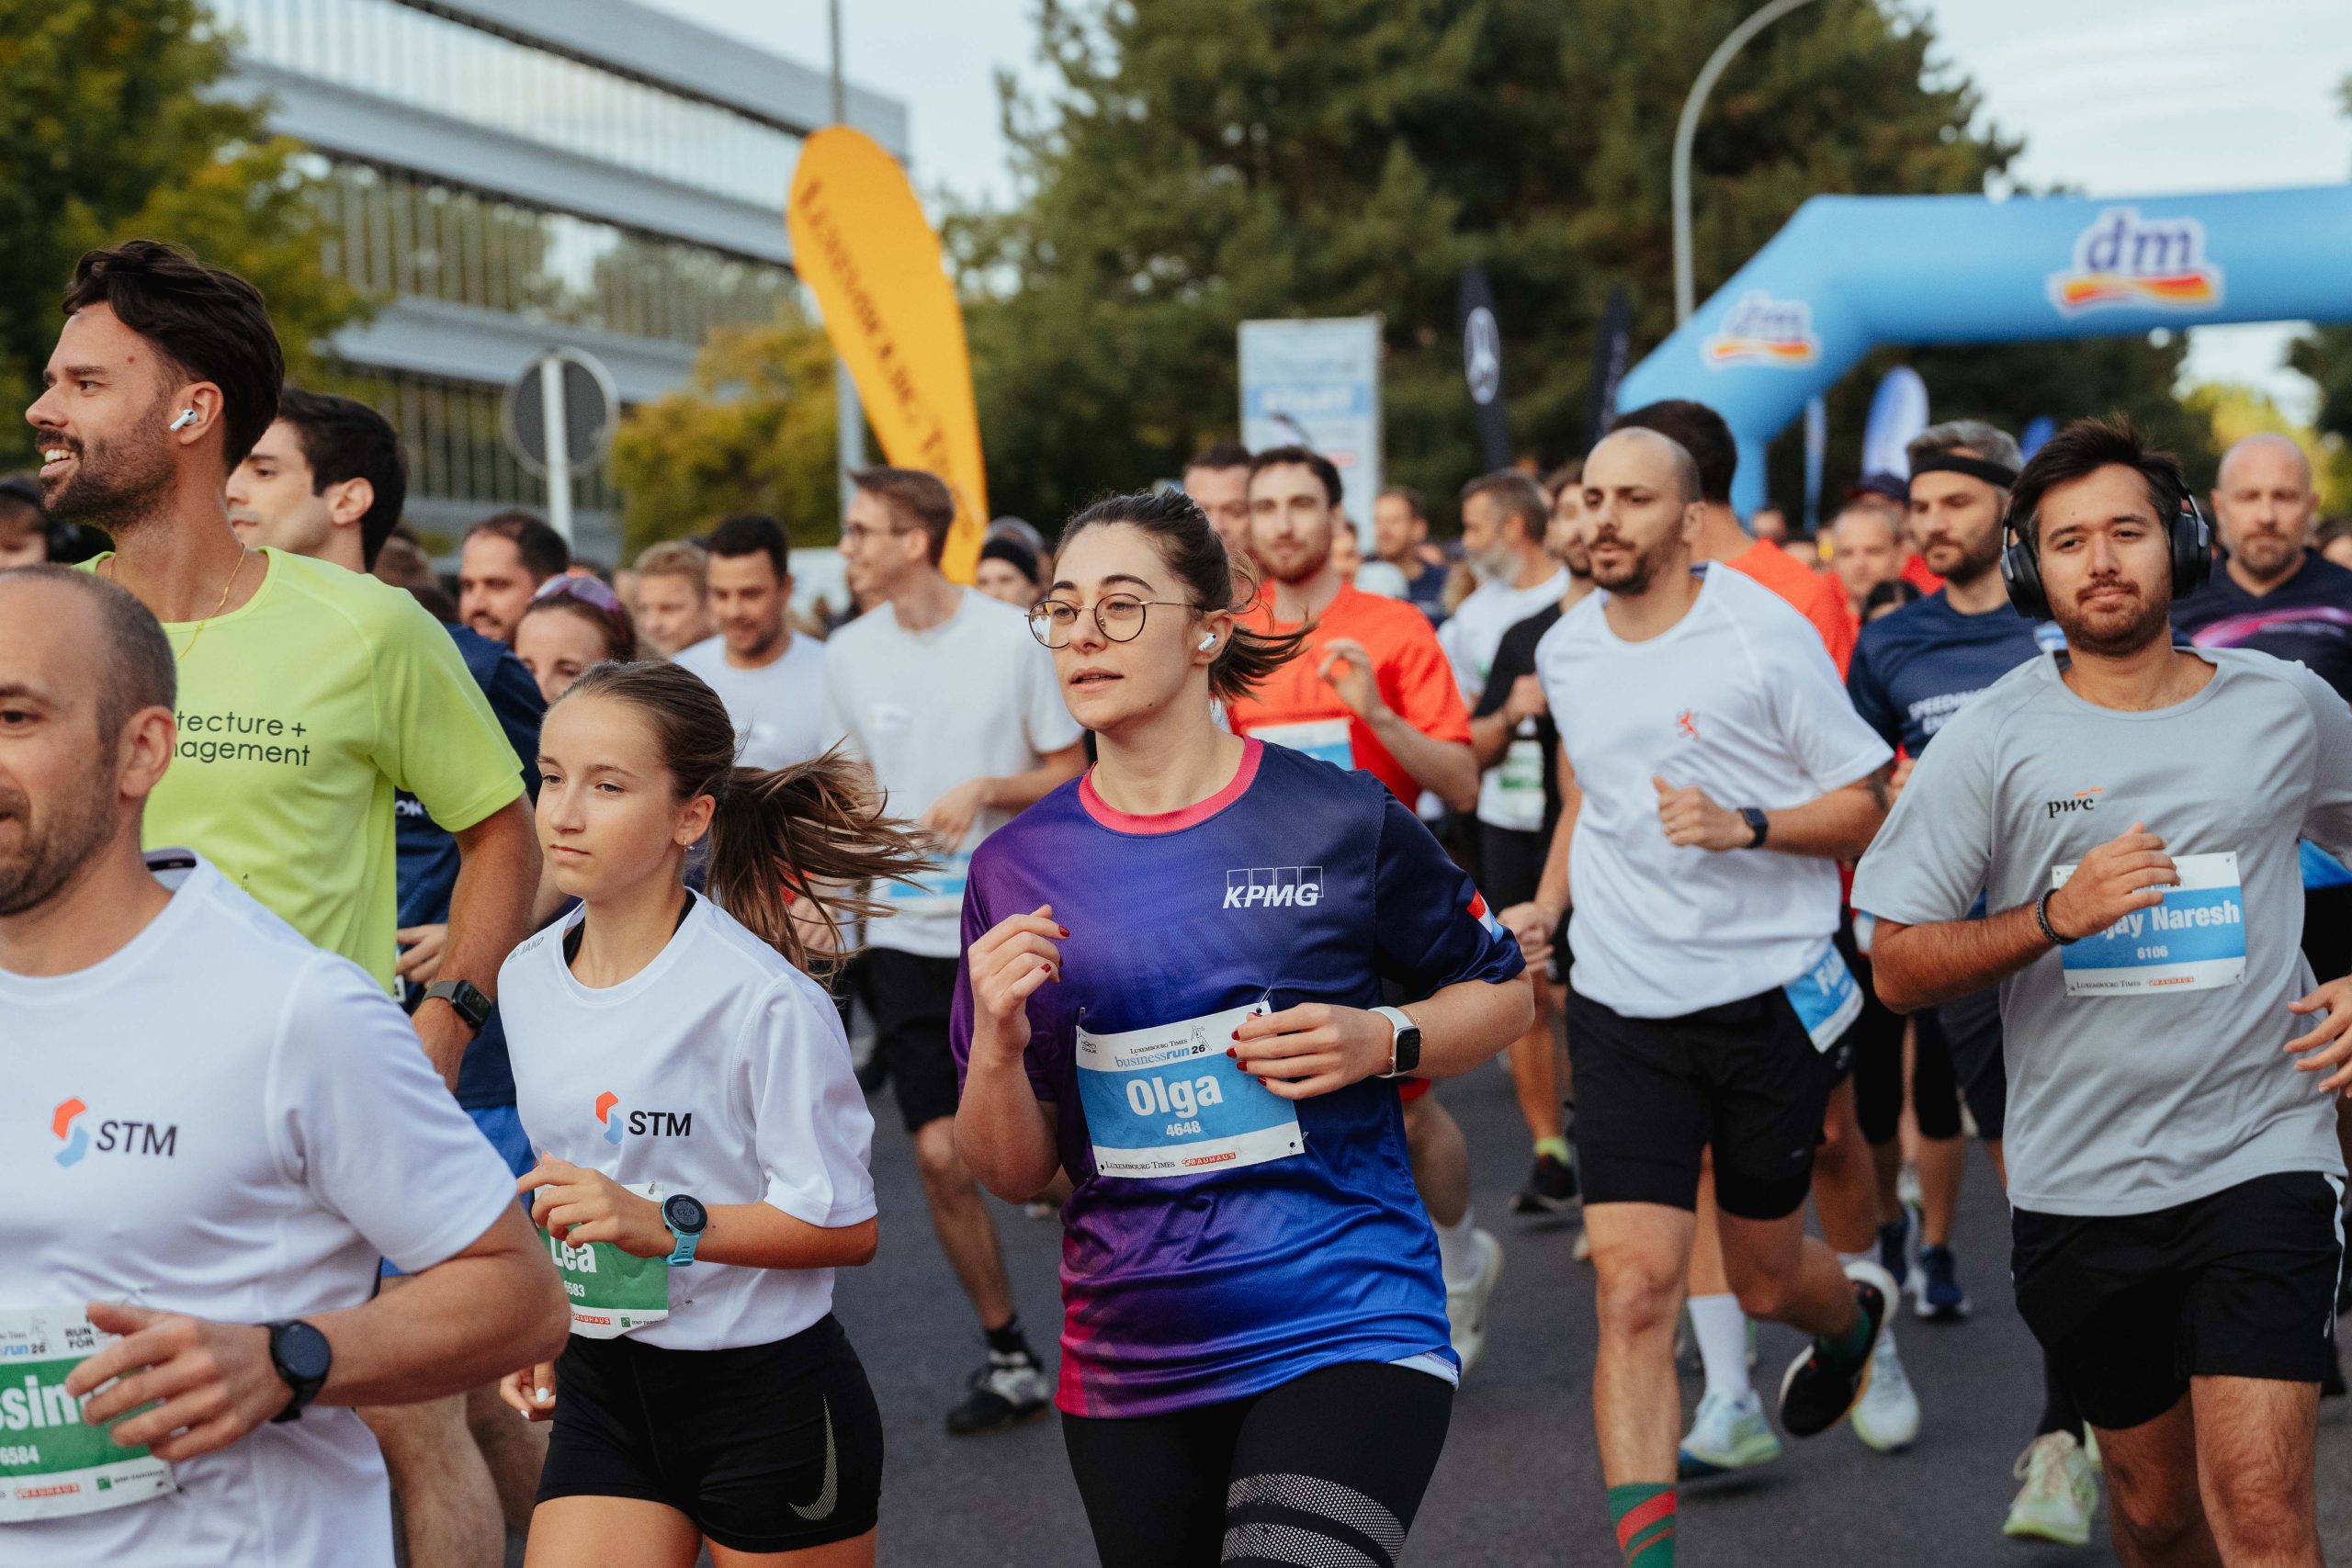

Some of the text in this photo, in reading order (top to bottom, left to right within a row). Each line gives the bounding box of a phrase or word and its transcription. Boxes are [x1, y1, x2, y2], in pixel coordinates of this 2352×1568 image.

[2087, 217, 2192, 272] dm
[1908, 689, 1984, 721] SPEEDIN
[176, 711, 284, 737] tecture
[175, 740, 311, 767] agement
[2047, 797, 2095, 818] pwc
[1222, 883, 1319, 909] KPMG
[2151, 899, 2240, 931] Naresh
[2137, 945, 2168, 959] 6106
[1191, 1043, 1205, 1055] 26
[1125, 1075, 1224, 1119] Olga
[628, 1111, 692, 1136] STM
[1166, 1121, 1201, 1137] 4648
[96, 1120, 177, 1157] STM
[1191, 1152, 1237, 1166] BAUHAUS
[550, 1235, 597, 1273] Lea
[64, 1326, 92, 1337] RUN
[0, 1445, 40, 1466] 6584
